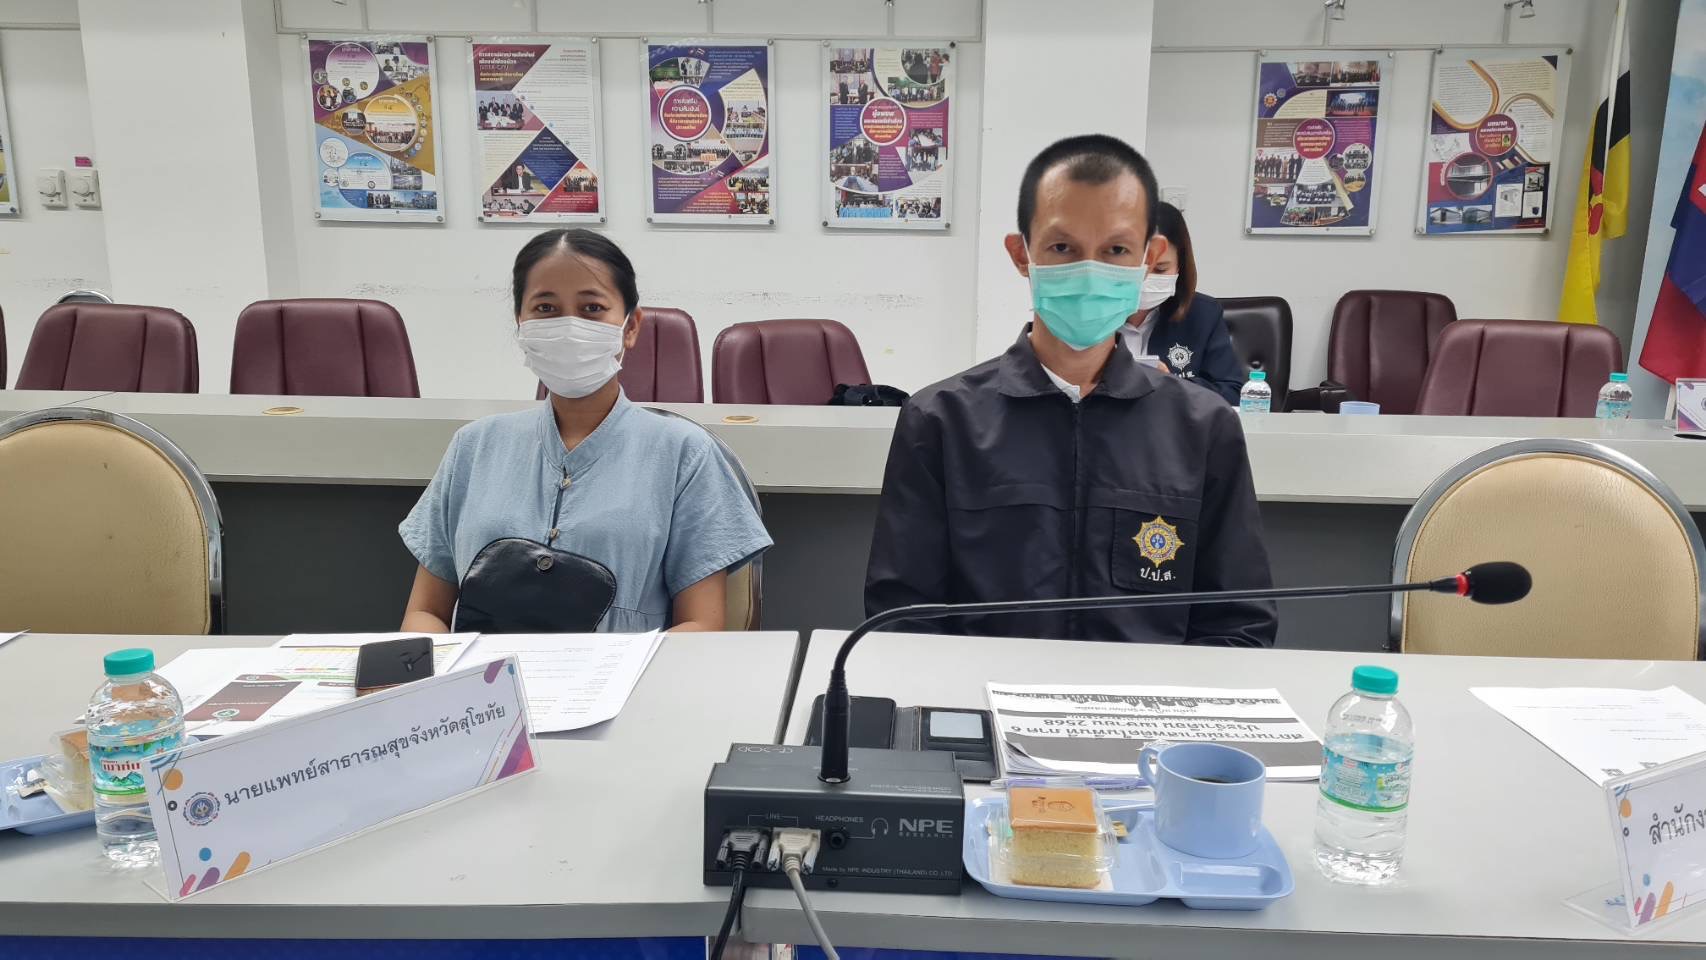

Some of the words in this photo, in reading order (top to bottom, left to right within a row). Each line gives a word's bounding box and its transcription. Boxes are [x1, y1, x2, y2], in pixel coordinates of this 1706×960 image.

[1140, 567, 1177, 581] ป.ป.ส.
[1043, 718, 1088, 727] 2568
[1092, 719, 1158, 729] เมษายน
[1162, 722, 1261, 732] ประจำเดือน
[224, 702, 506, 806] นายแพทย์สาธารณสุขจังหวัดสุโขทัย
[815, 815, 865, 823] HEADPHONES
[1649, 803, 1706, 845] สำนักง
[899, 818, 954, 833] NPE
